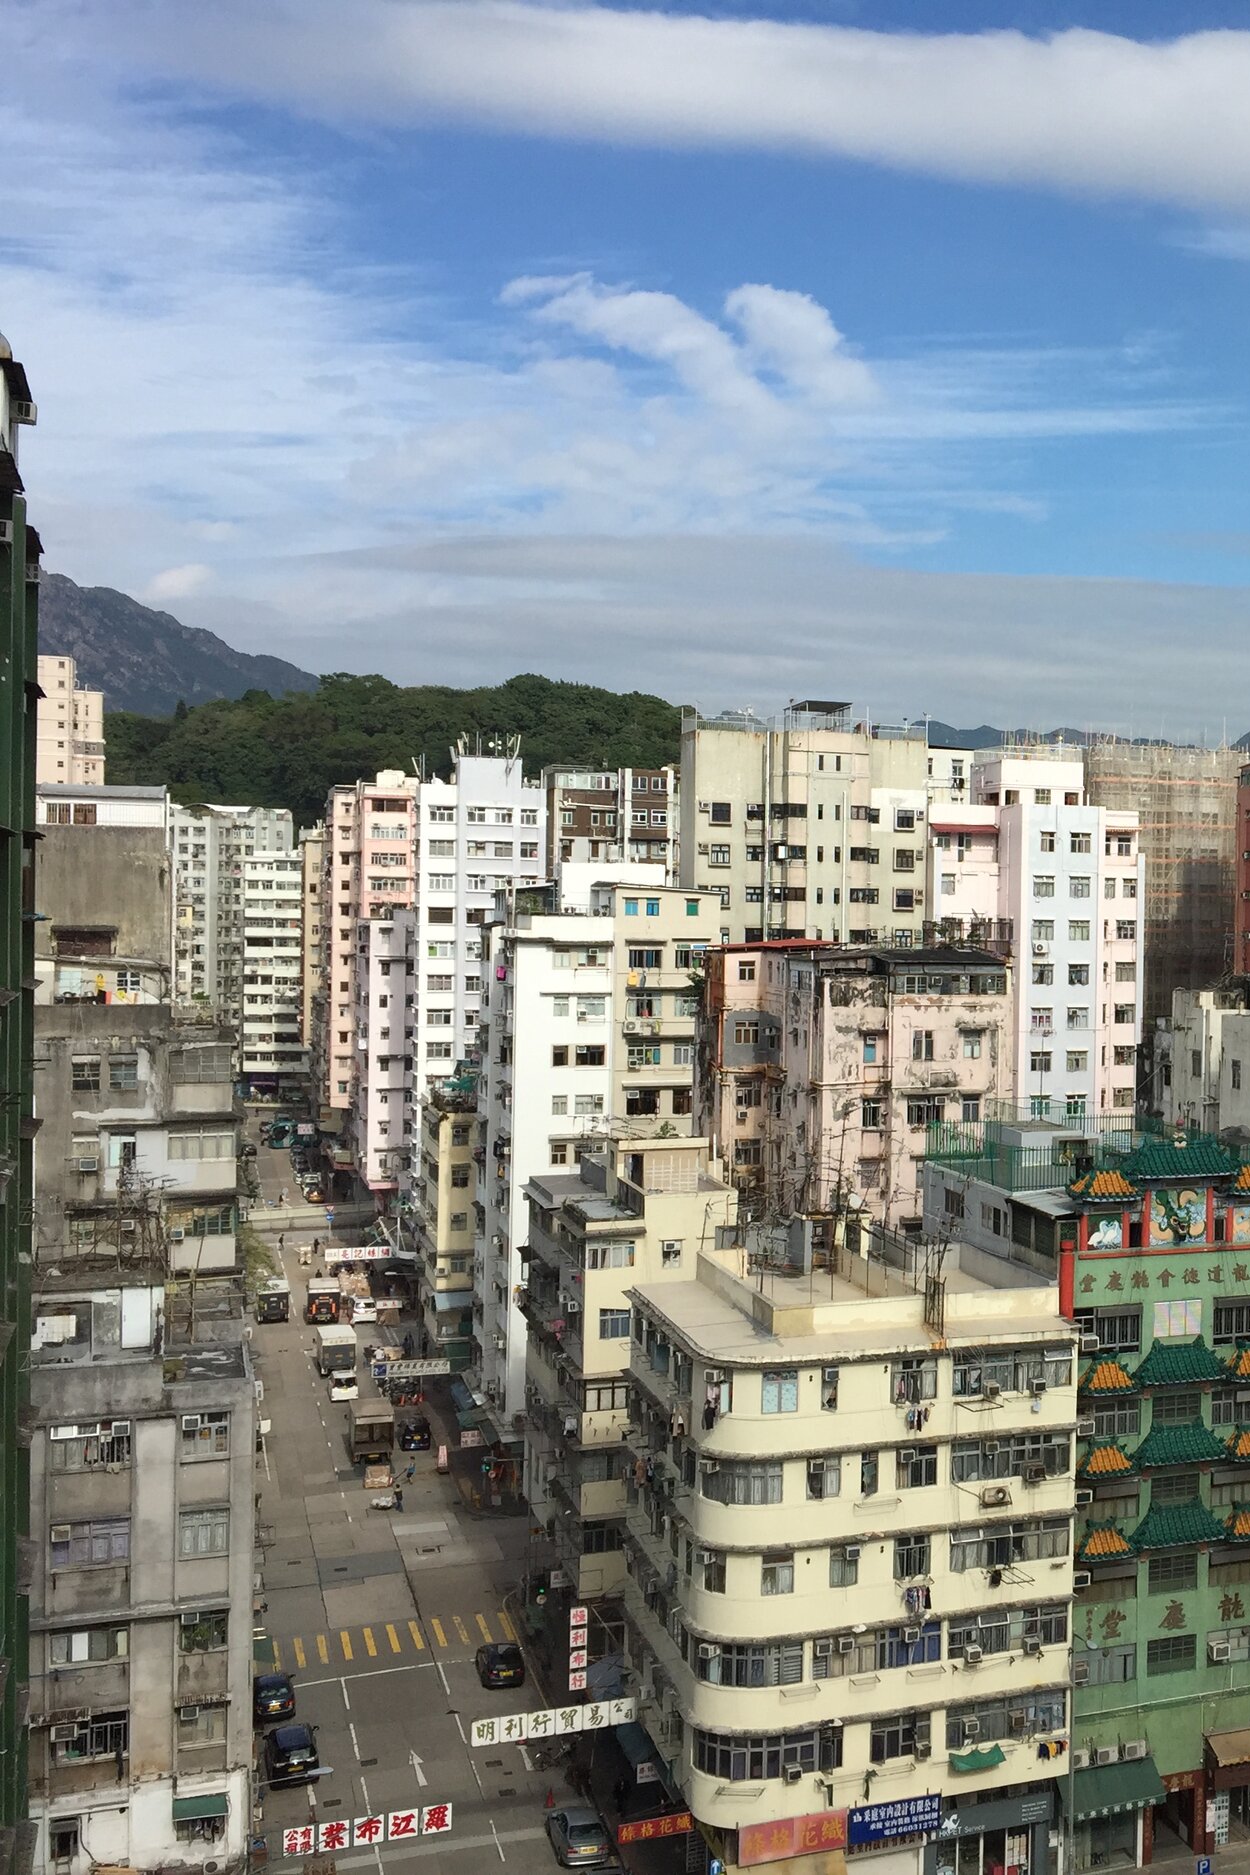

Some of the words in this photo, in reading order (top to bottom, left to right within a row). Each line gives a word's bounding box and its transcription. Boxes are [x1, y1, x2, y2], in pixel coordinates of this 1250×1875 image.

[1098, 1592, 1245, 1640] 龍慶堂
[476, 1701, 633, 1742] 明利行貿易公司
[898, 1820, 938, 1833] 66031278
